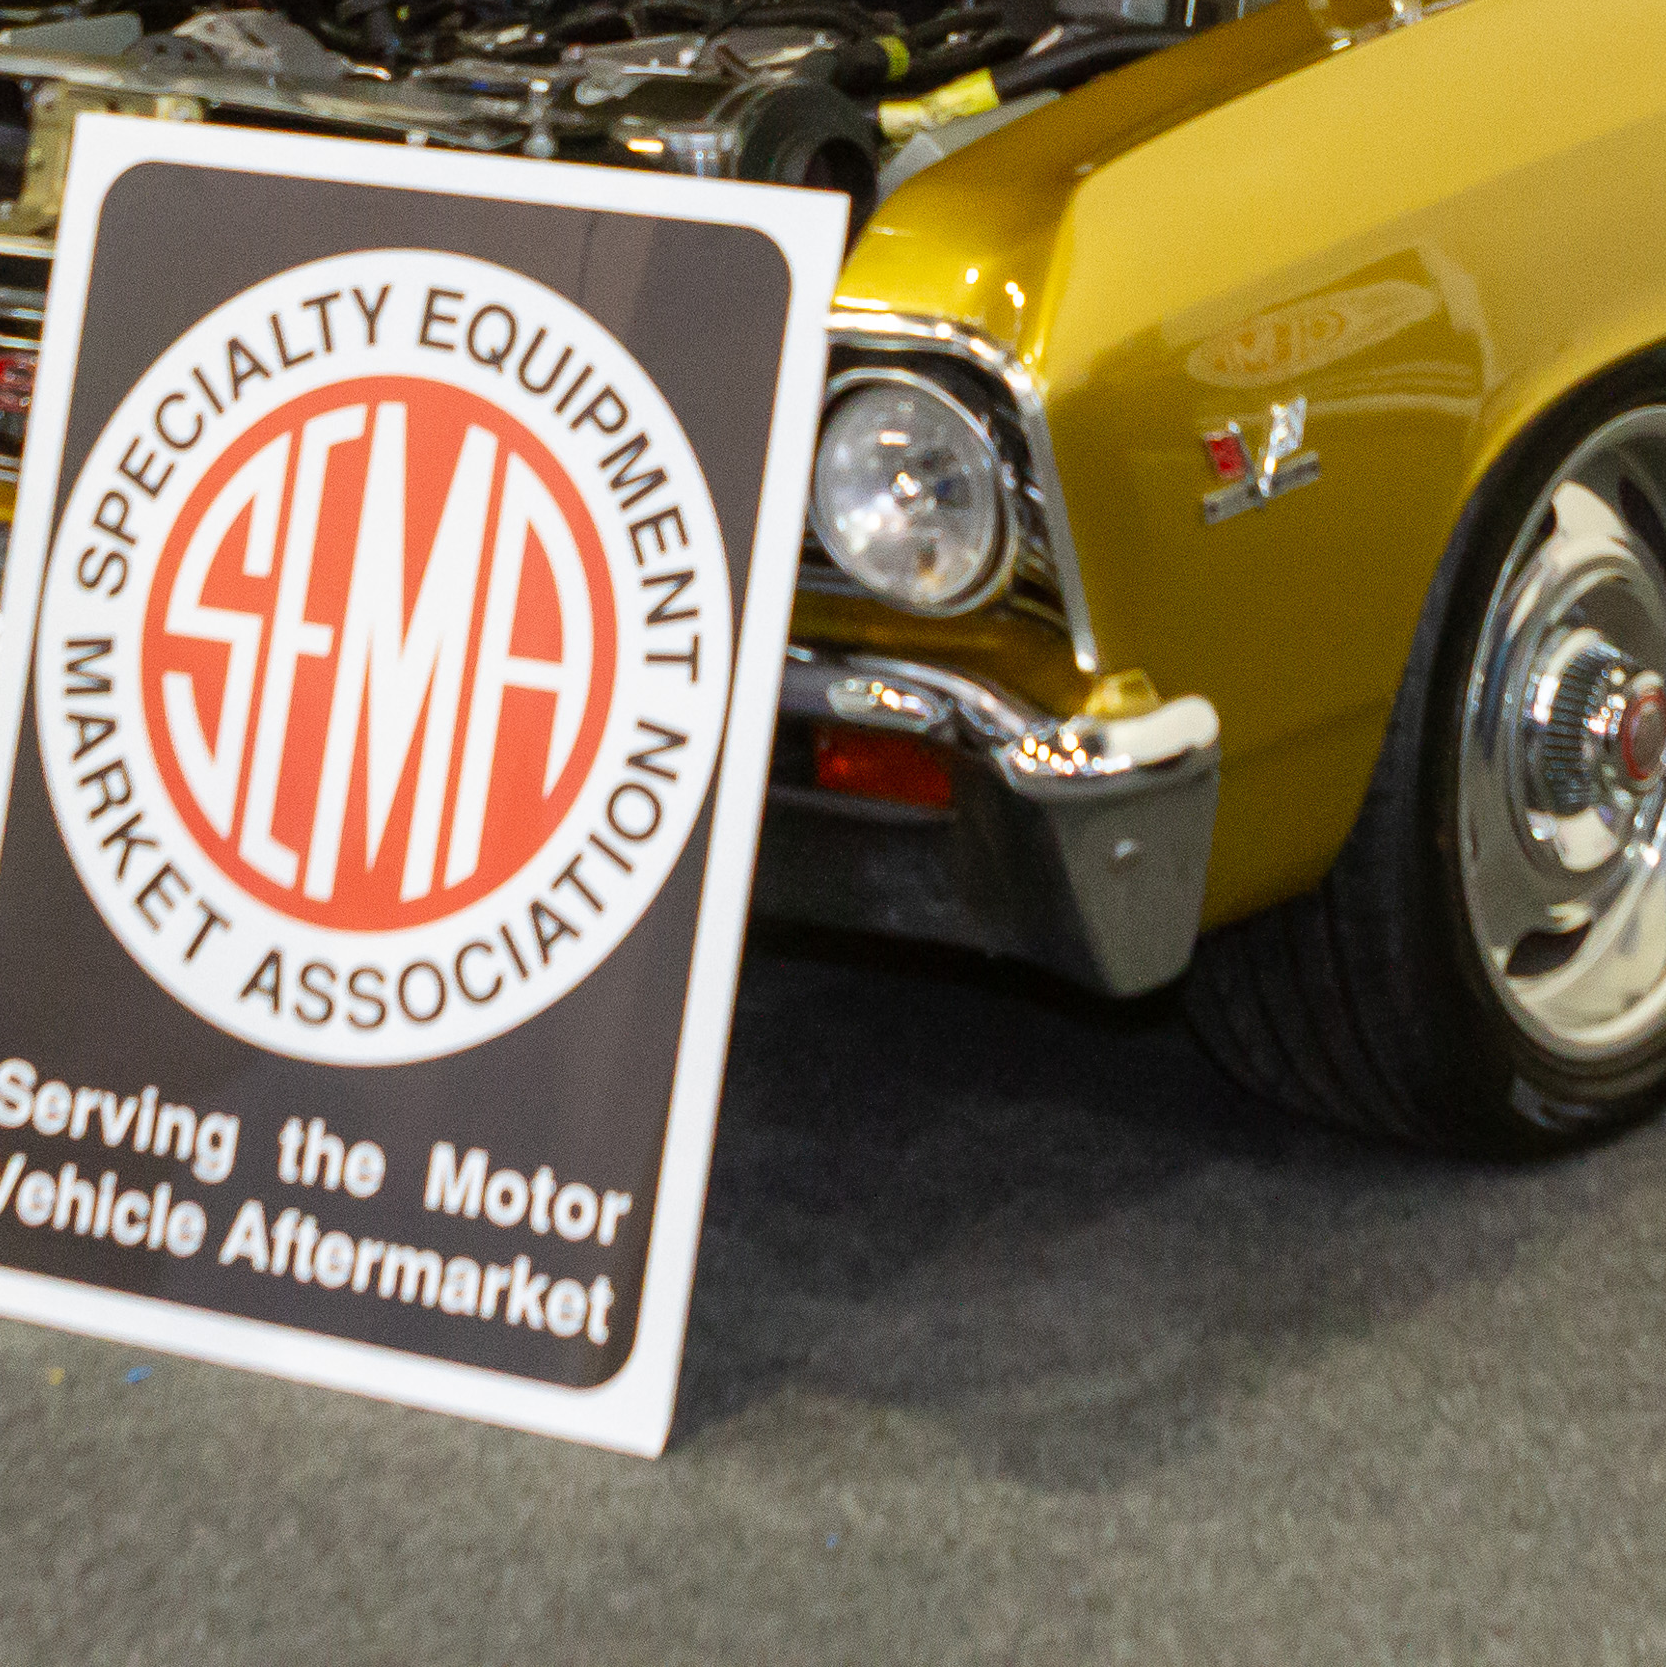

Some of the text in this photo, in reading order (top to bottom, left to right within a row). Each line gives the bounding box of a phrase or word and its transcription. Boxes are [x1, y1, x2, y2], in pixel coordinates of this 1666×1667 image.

[74, 283, 702, 684] SPECIALTY EQUIPMENT
[161, 401, 595, 904] SEMA
[63, 635, 691, 1032] MARKET ASSOCIATION
[219, 1199, 614, 1345] Aftermarket
[278, 1116, 386, 1198] the
[424, 1141, 633, 1245] Motor
